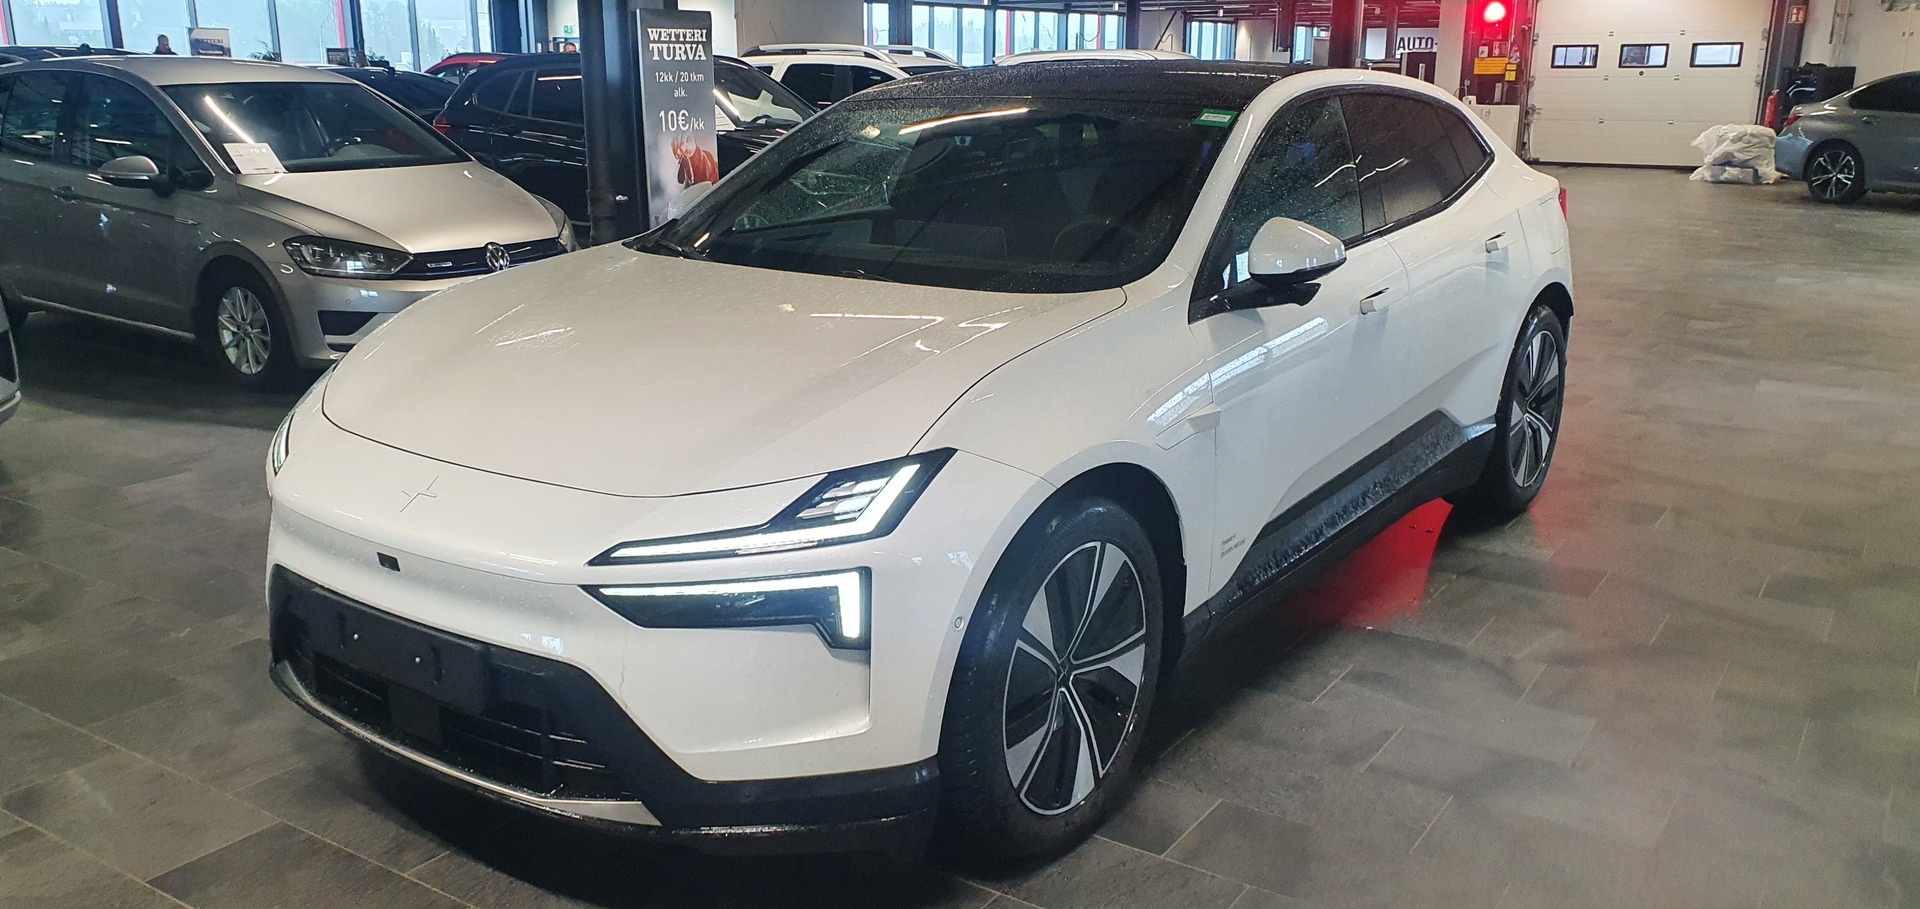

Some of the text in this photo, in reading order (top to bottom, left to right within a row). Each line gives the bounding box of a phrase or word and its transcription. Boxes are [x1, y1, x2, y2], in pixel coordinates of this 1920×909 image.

[646, 27, 707, 42] WETTERI
[649, 43, 707, 61] TURVA
[655, 70, 705, 83] 12kk / 20 tkm
[673, 87, 688, 98] alk.
[659, 109, 705, 132] 10€/kk
